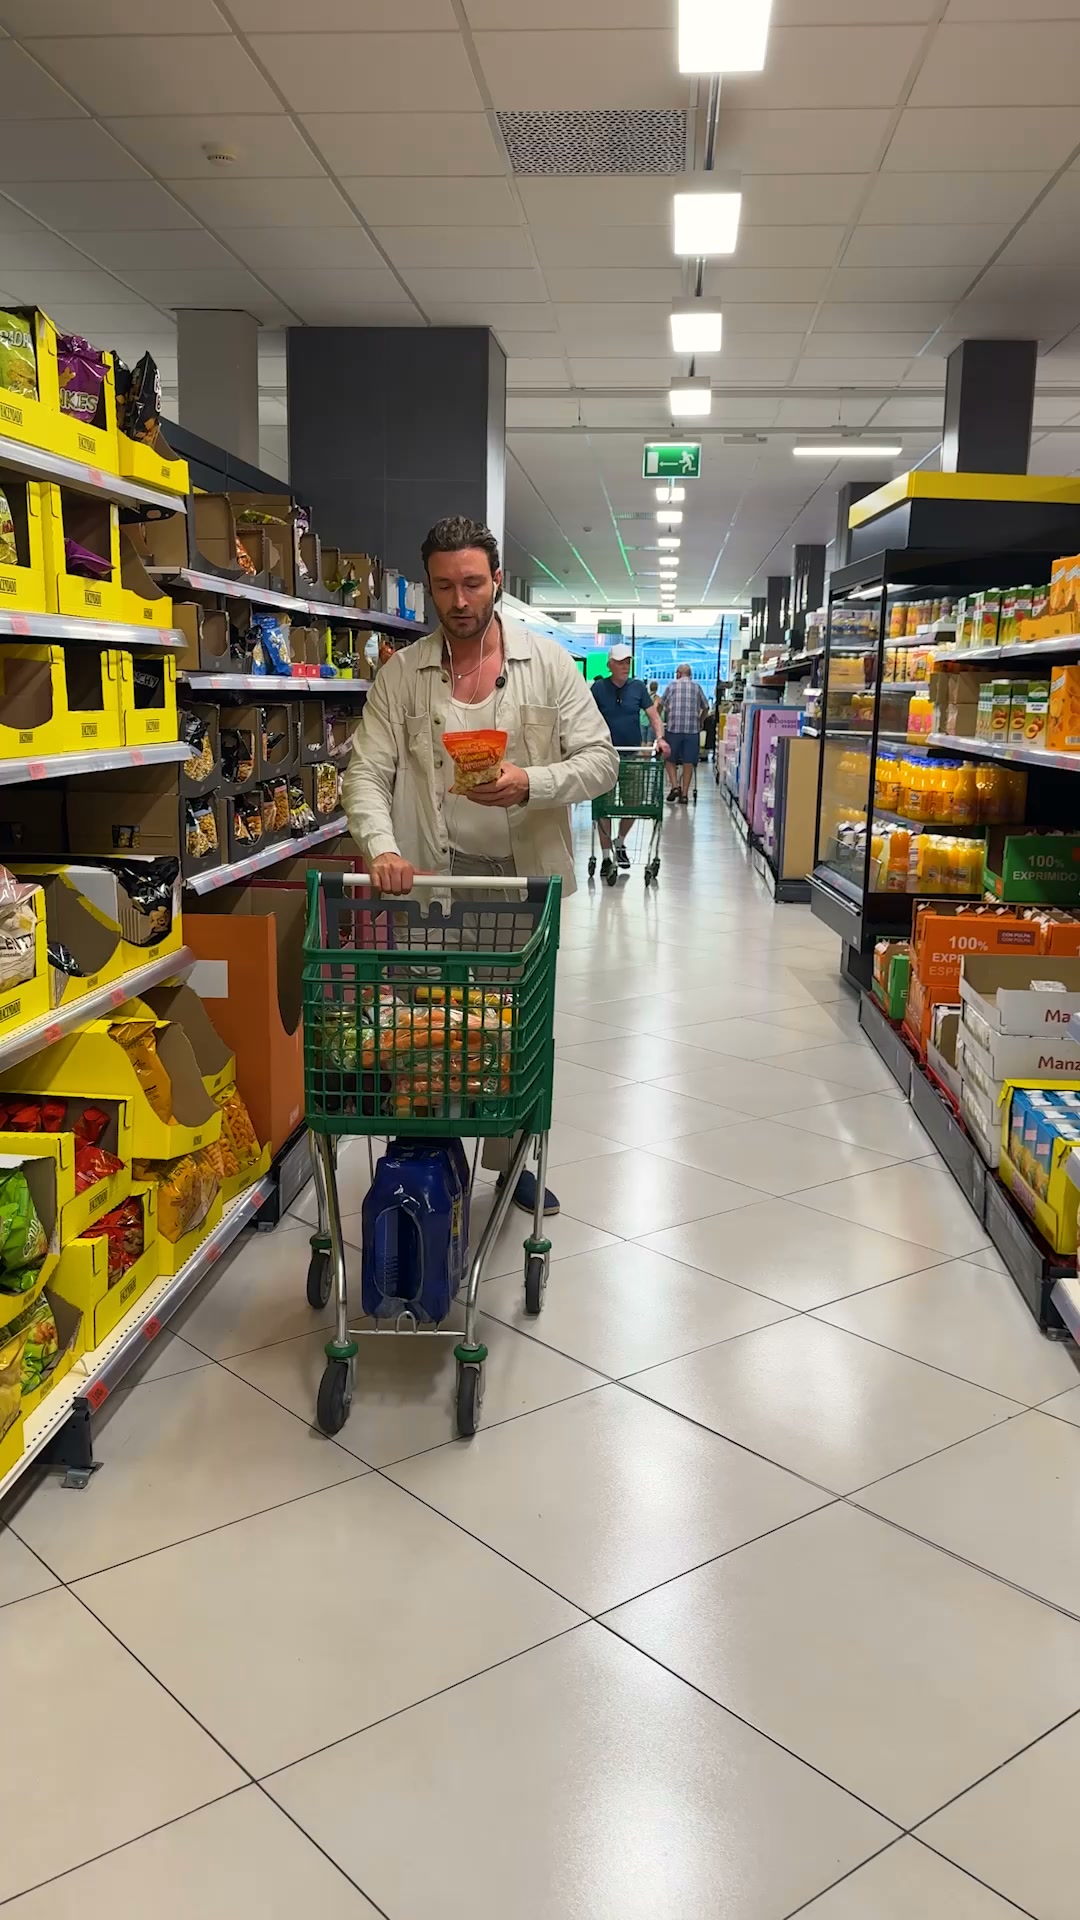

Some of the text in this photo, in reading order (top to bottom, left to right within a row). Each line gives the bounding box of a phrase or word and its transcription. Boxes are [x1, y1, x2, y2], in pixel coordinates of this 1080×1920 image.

[1028, 855, 1064, 868] 100%
[1013, 871, 1078, 881] EXPRIMIDO
[948, 935, 989, 952] 100%
[1045, 1009, 1071, 1023] Ma
